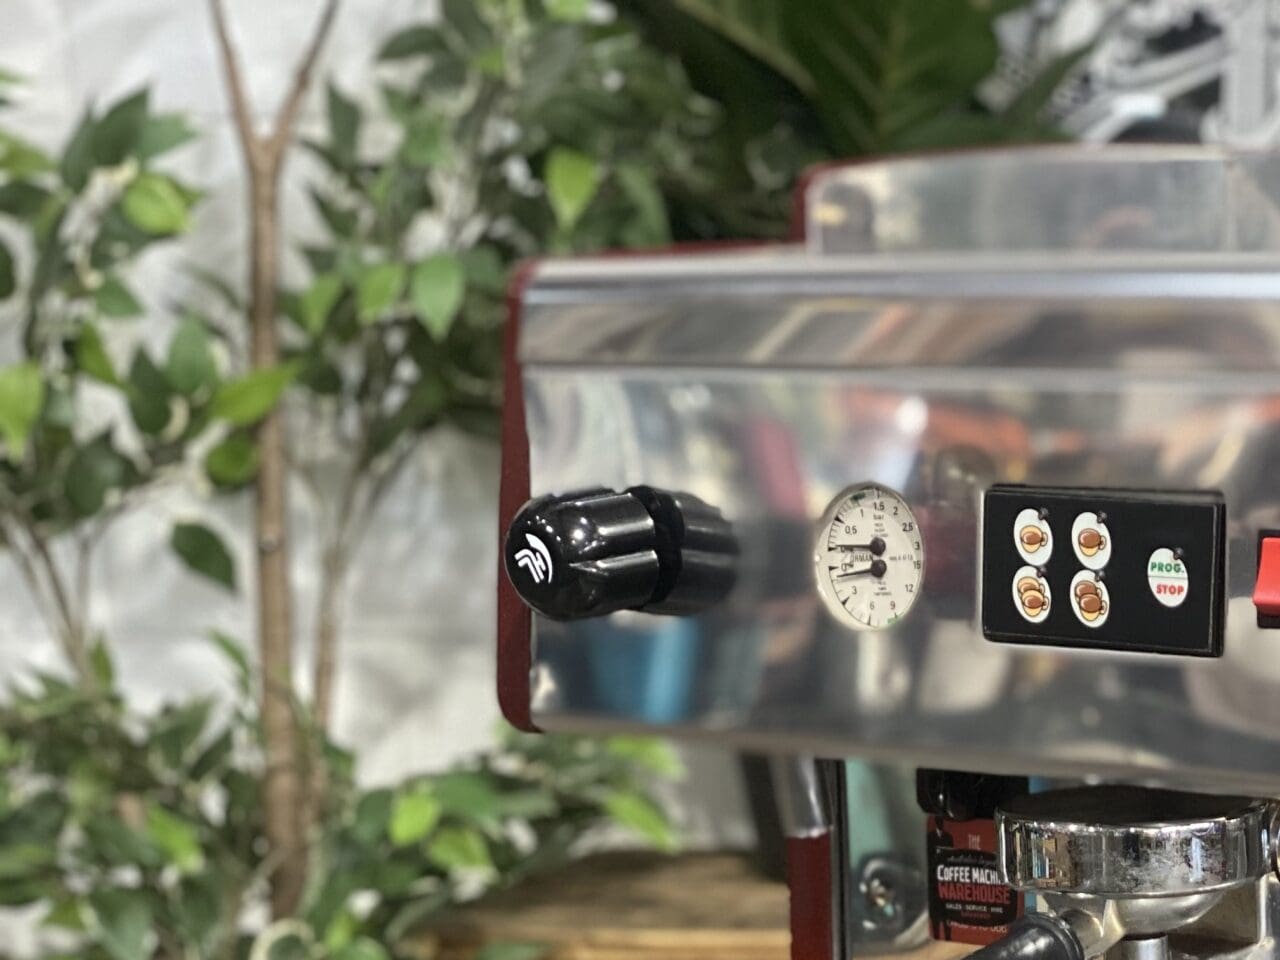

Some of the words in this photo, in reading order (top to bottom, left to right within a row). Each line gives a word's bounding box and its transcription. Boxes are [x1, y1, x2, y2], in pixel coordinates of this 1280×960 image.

[1150, 561, 1184, 573] PROG.
[1156, 584, 1184, 595] STOP
[937, 864, 970, 882] COFFEE
[938, 882, 1010, 904] WAREHOUSE
